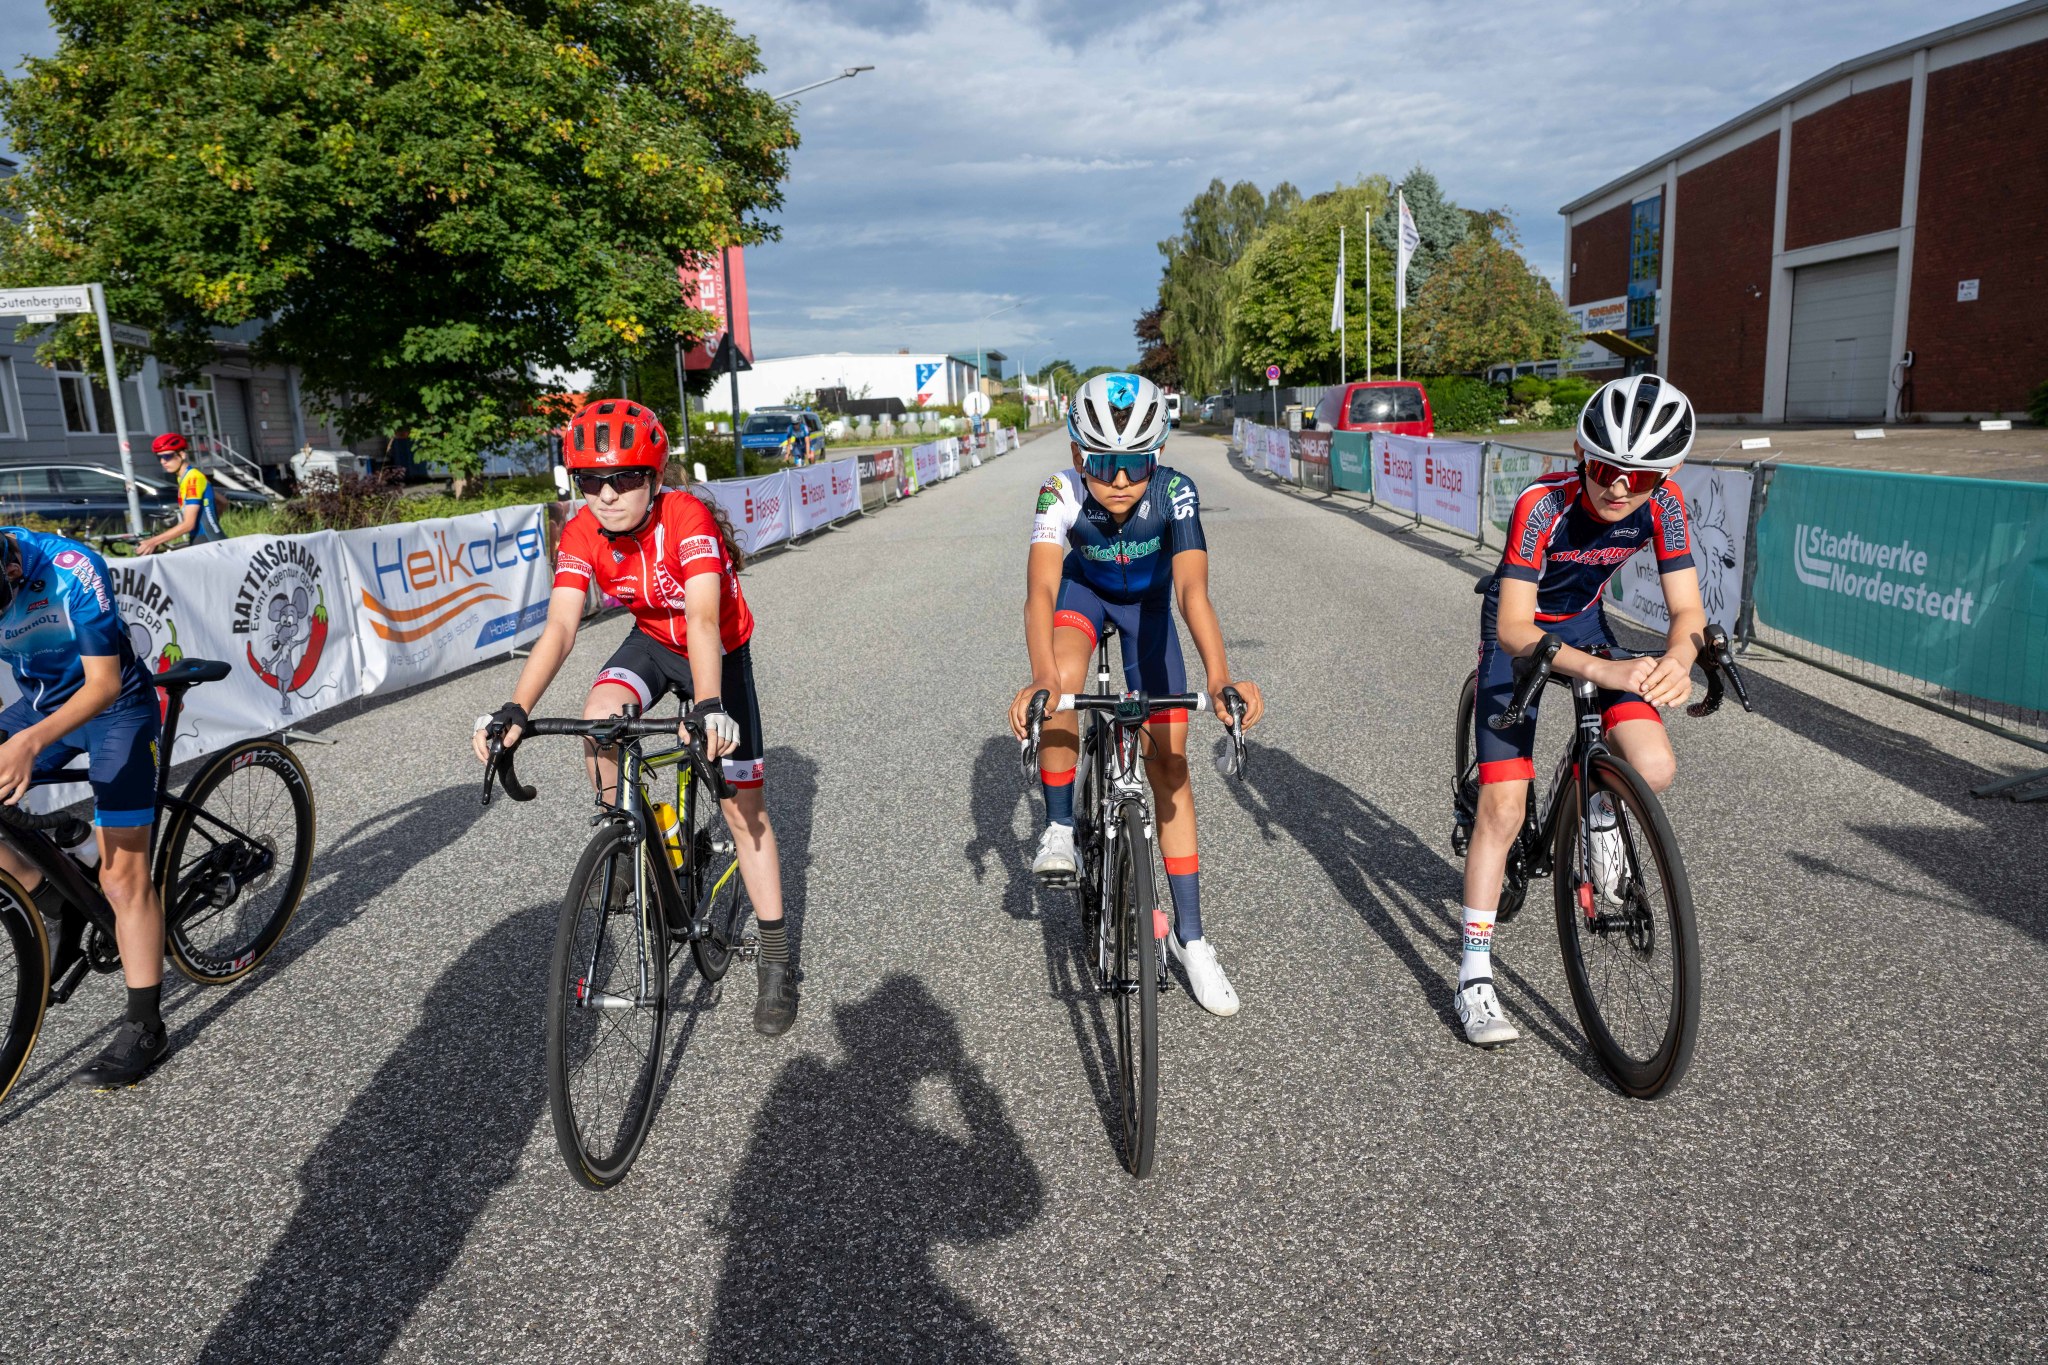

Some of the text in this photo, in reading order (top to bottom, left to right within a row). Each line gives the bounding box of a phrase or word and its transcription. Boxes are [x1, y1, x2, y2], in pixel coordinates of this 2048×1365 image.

[0, 294, 82, 308] Gutenbergring
[1392, 453, 1413, 485] Haspa
[1435, 459, 1462, 498] Haspa
[1650, 486, 1687, 551] RATFORD
[373, 512, 547, 600] Heikotel
[1808, 526, 1928, 576] Stadtwerke
[109, 567, 173, 617] CHARF
[232, 540, 322, 634] RATTENSCHARF
[251, 567, 315, 631] Event Agentur GbR
[1829, 563, 1974, 625] Norderstedt
[5, 614, 59, 640] BUCHHOLZ
[135, 605, 163, 634] GbR
[1464, 936, 1489, 946] BOR
